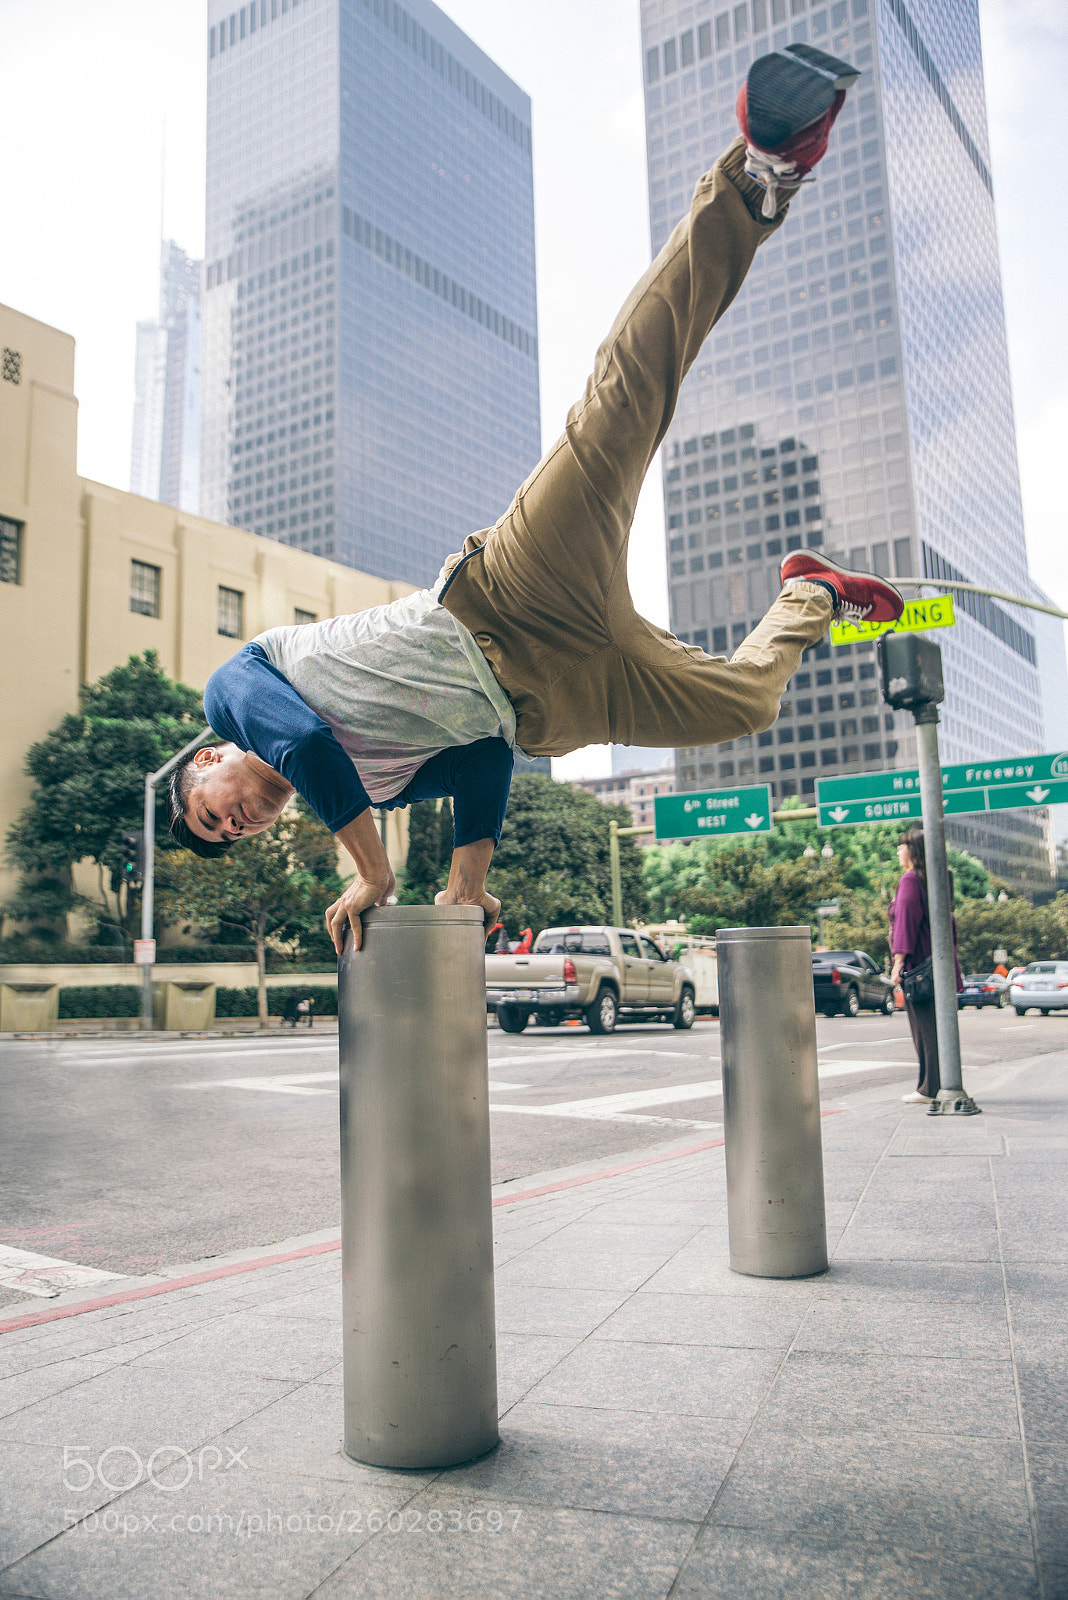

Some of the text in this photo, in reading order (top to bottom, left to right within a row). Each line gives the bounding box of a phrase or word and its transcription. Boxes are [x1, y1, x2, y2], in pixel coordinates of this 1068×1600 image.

[893, 764, 1035, 790] Harr Freeway
[706, 796, 740, 810] Street
[864, 801, 910, 818] SOUTH
[697, 815, 727, 828] WEST
